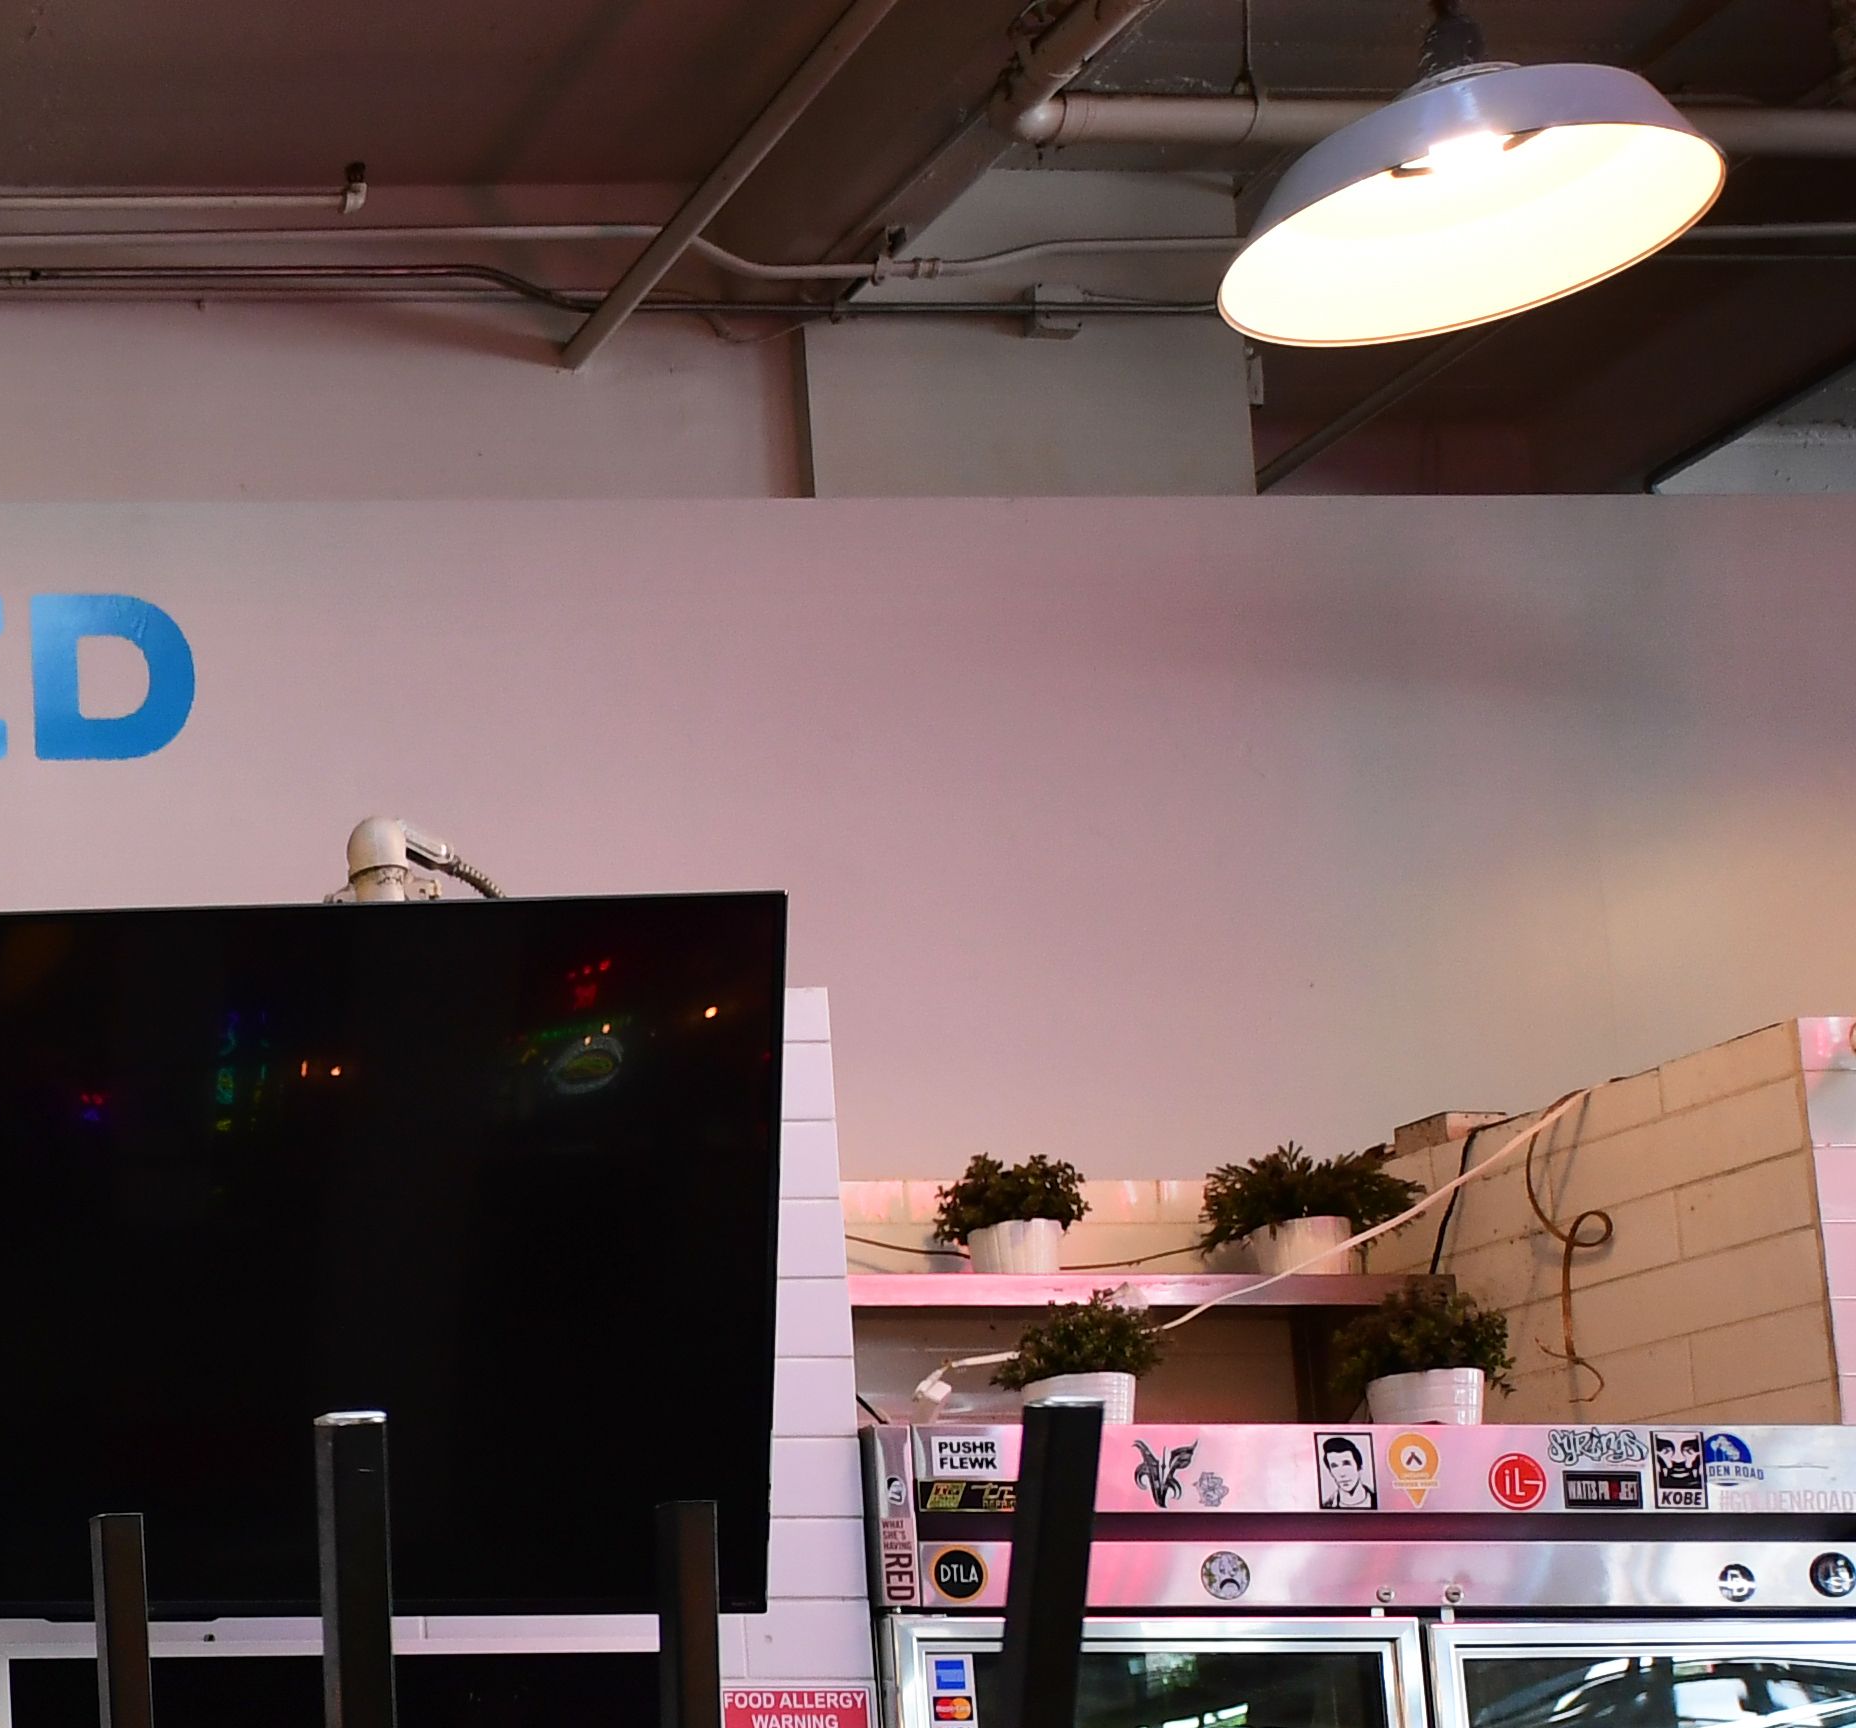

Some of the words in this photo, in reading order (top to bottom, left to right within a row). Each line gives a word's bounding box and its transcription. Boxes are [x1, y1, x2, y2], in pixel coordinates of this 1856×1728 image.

[938, 1441, 997, 1454] PUSHR
[939, 1456, 998, 1471] FLEWK
[1734, 1466, 1765, 1480] ROAD
[1660, 1491, 1702, 1505] KOBE
[1720, 1490, 1856, 1511] #GOLDENROAD
[885, 1553, 915, 1601] RED
[939, 1564, 979, 1583] DTLA
[723, 1692, 775, 1708] FOOD
[779, 1692, 865, 1708] ALLERGY
